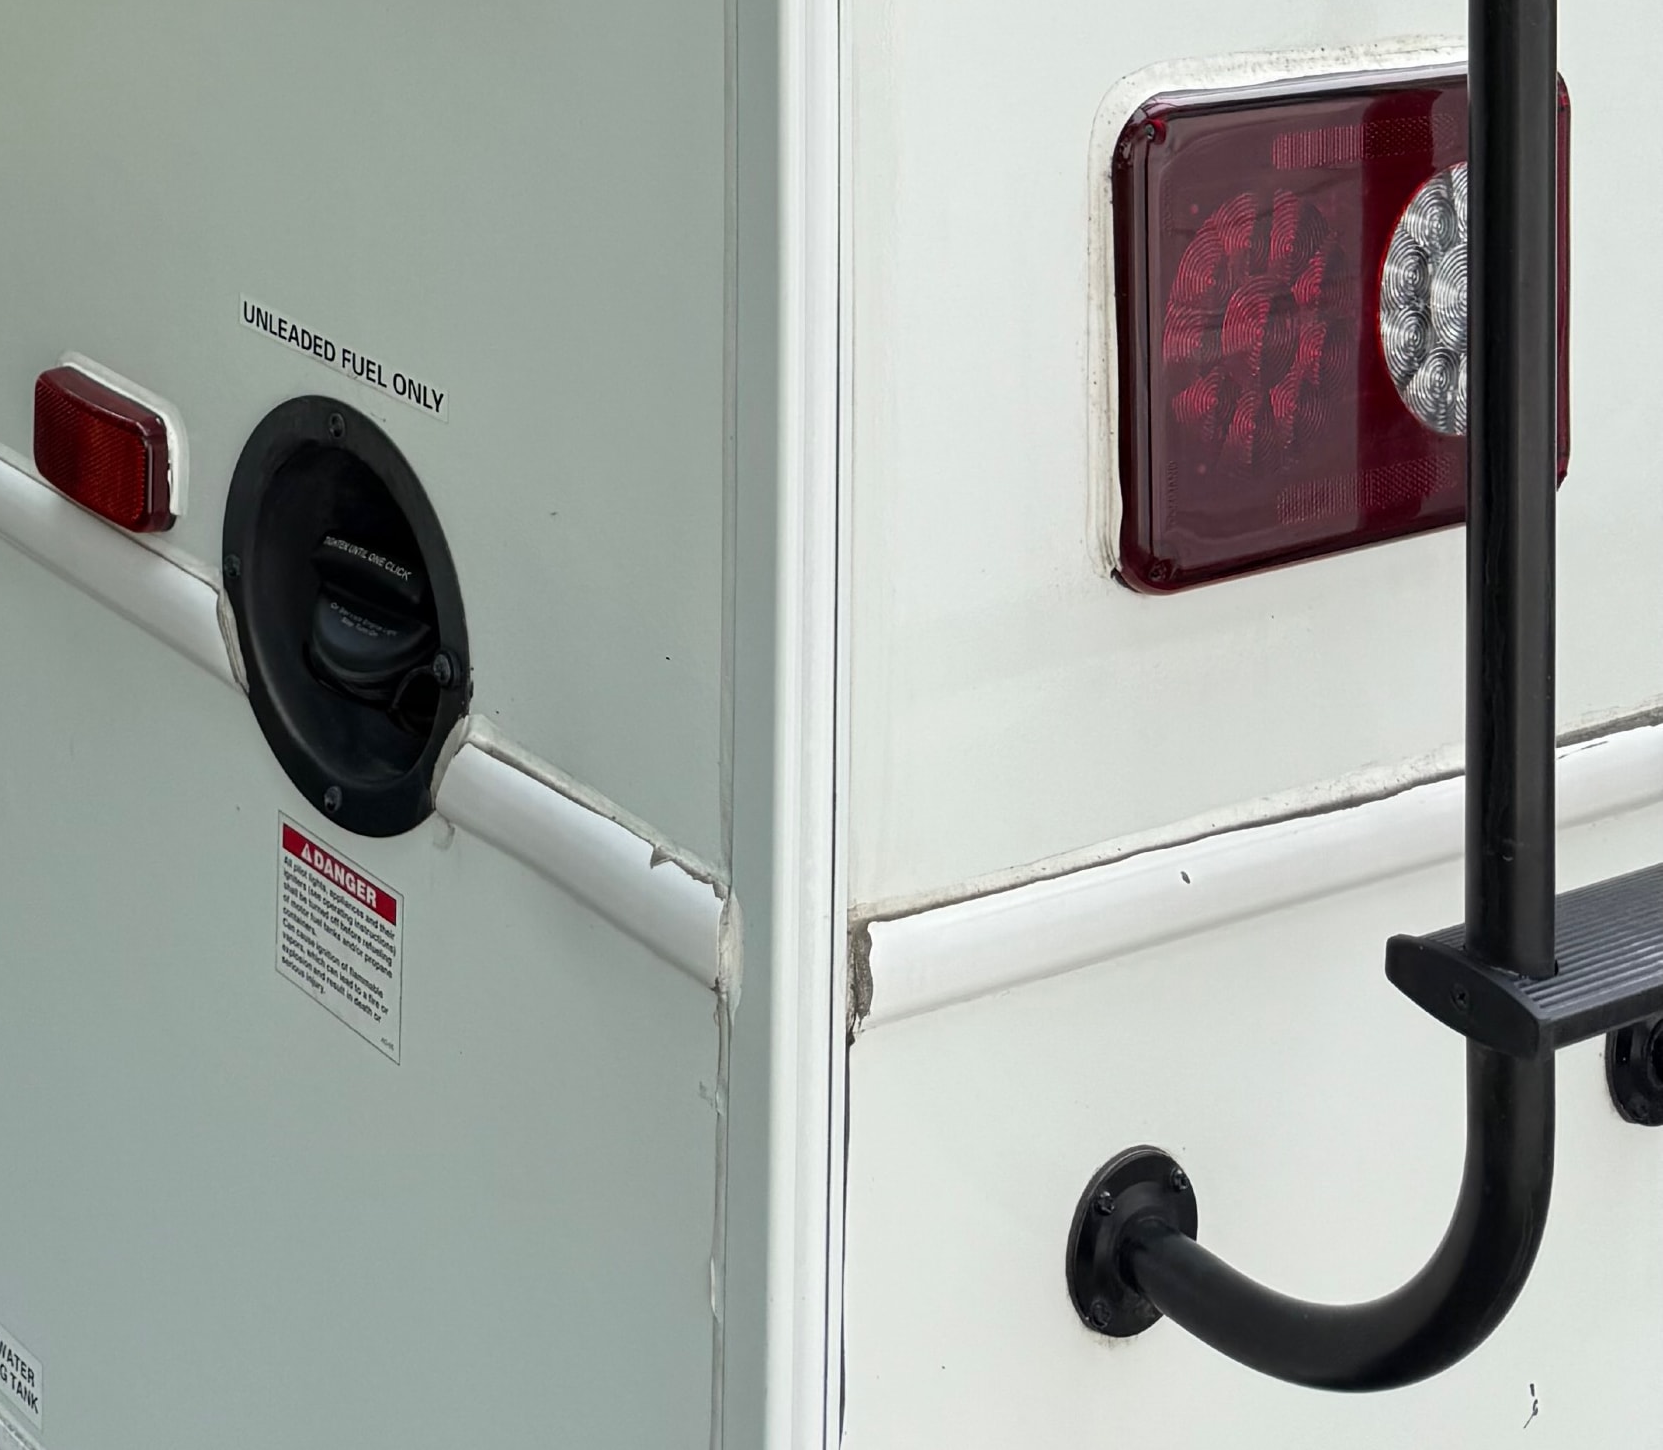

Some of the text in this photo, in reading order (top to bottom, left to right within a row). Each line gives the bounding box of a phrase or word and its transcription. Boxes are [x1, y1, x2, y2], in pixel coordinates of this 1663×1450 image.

[243, 301, 444, 413] UNLEADED FUEL ONLY
[368, 553, 387, 567] ONE
[385, 561, 412, 581] CLICK
[313, 849, 377, 908] DANGER
[9, 1372, 39, 1414] TANK
